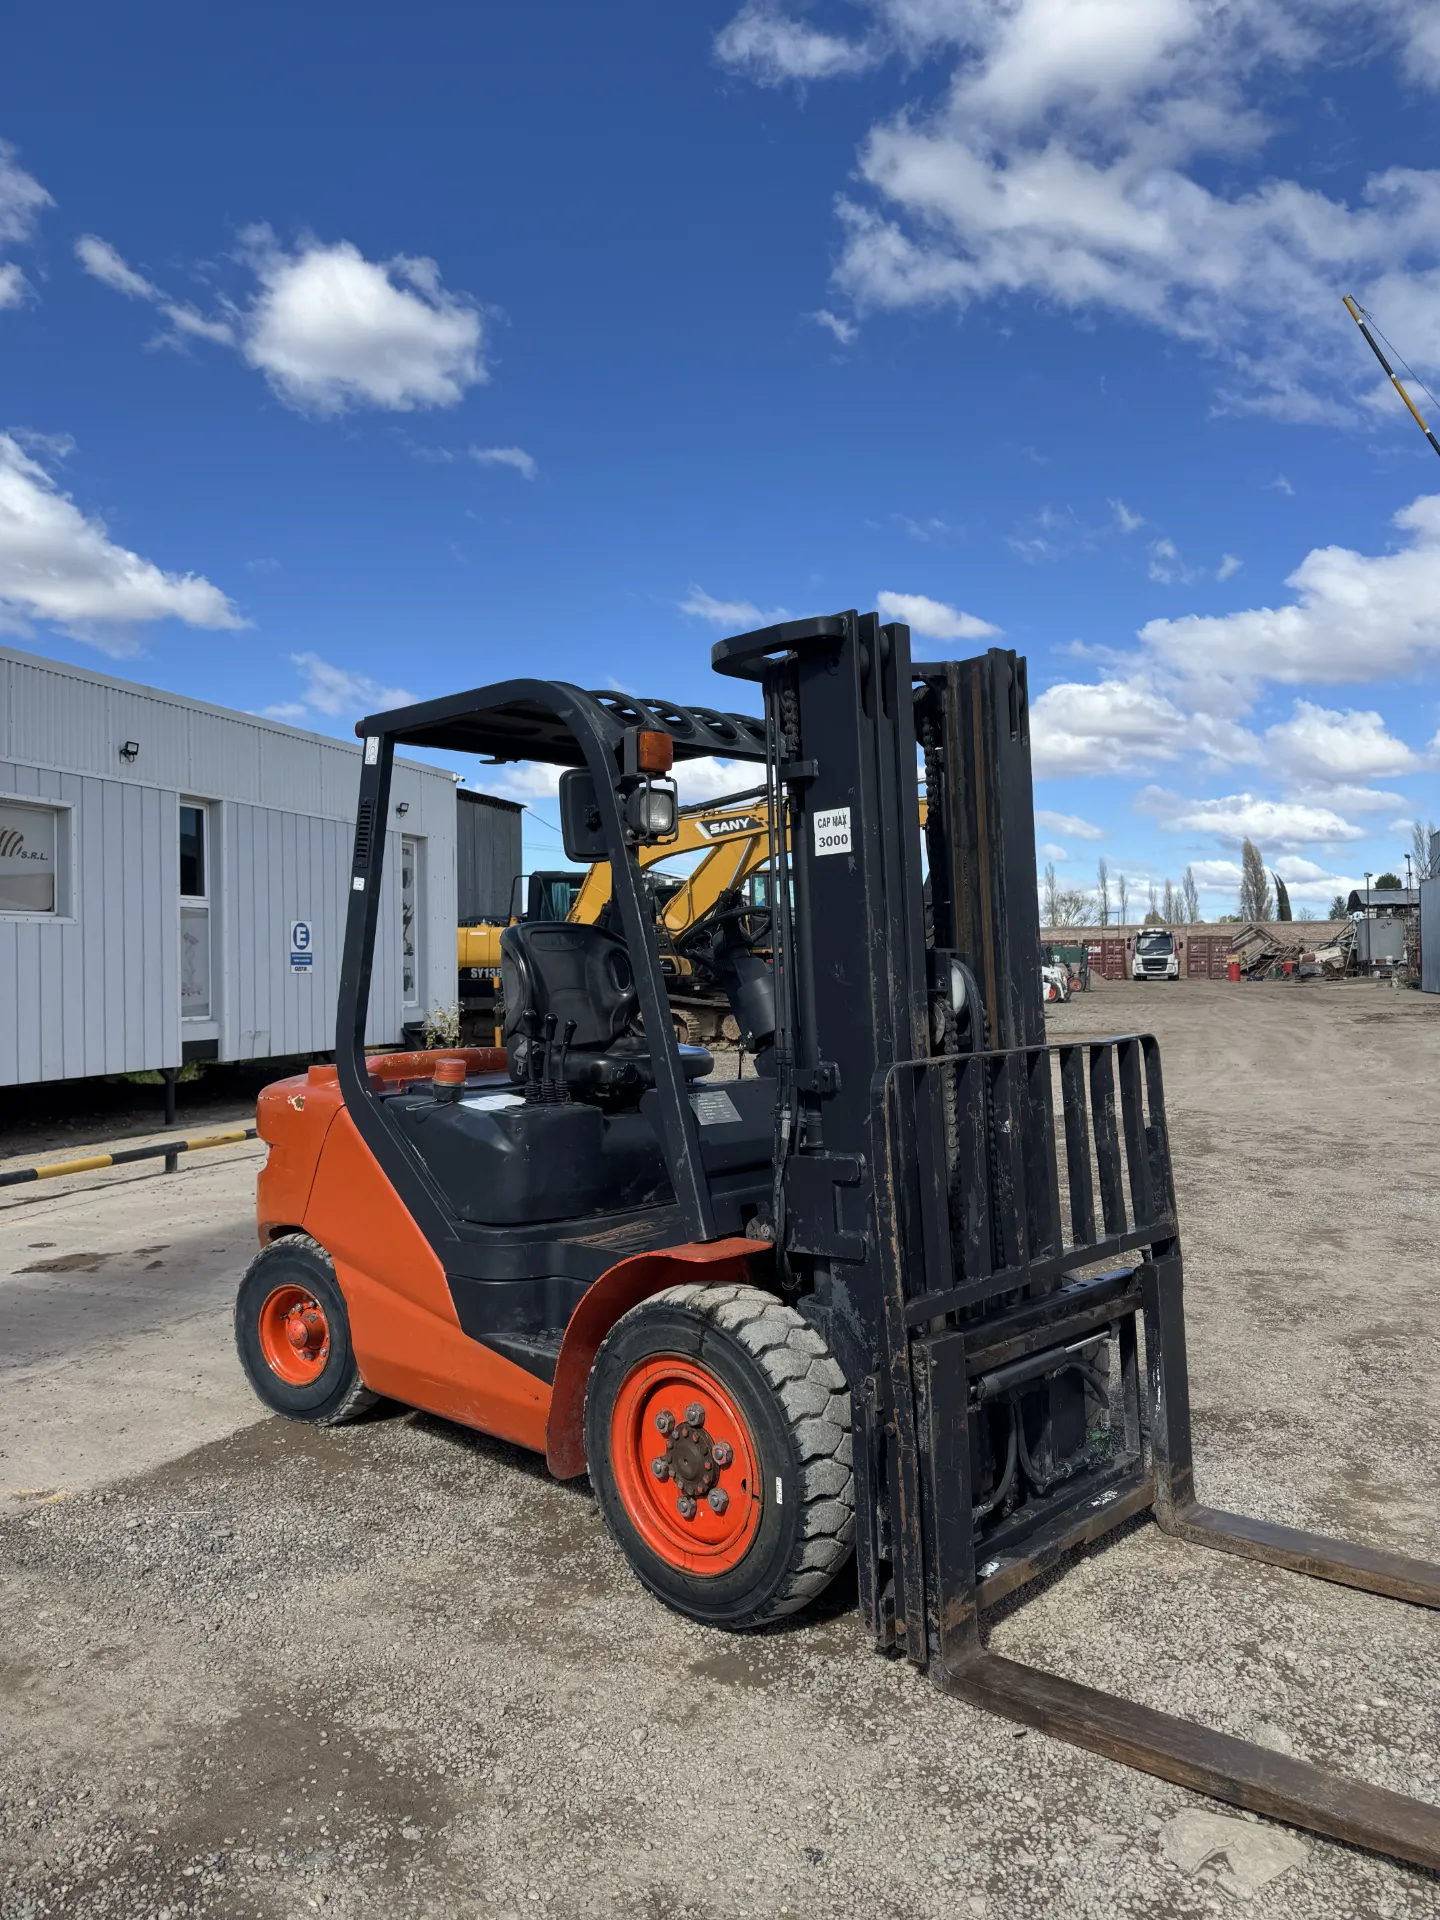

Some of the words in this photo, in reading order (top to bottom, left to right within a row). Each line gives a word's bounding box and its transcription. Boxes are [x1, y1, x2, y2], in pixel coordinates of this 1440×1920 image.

[709, 817, 750, 834] SANY
[817, 817, 831, 828] CAP
[832, 815, 847, 827] MAX
[818, 834, 849, 848] 3000
[20, 851, 48, 861] S.R.L.
[296, 926, 307, 946] E
